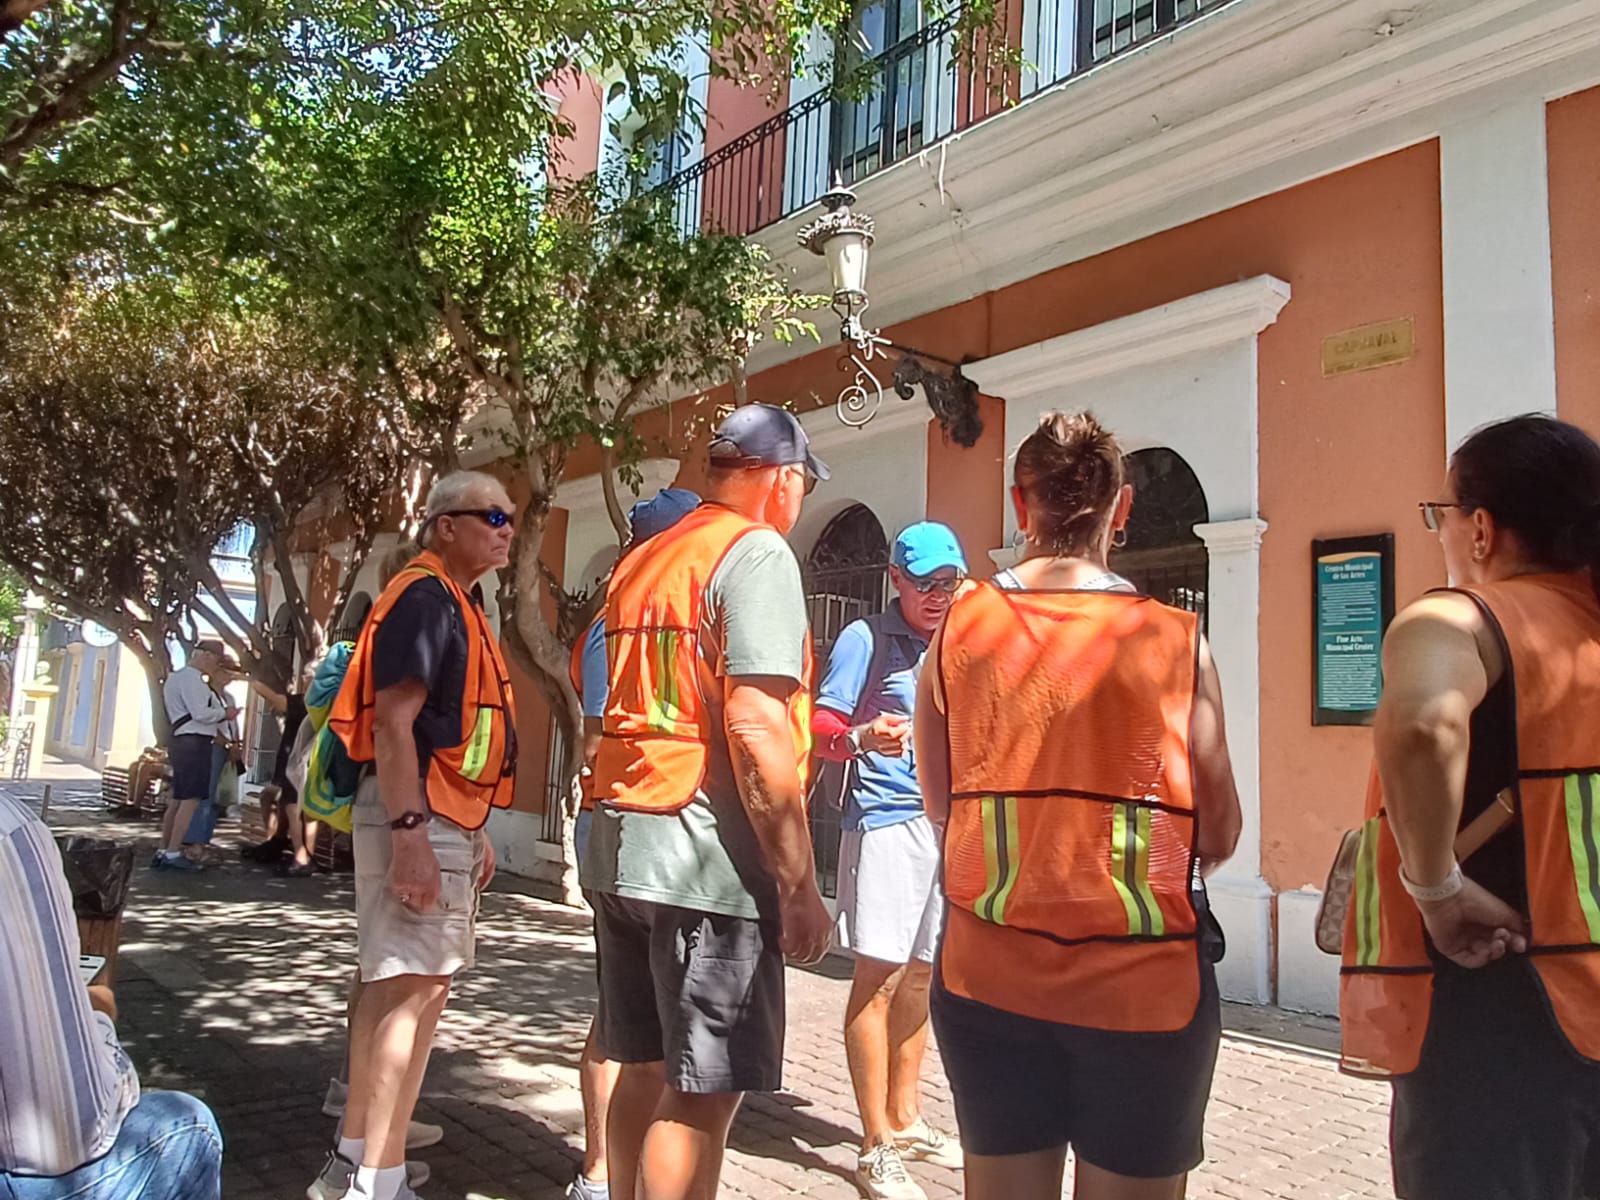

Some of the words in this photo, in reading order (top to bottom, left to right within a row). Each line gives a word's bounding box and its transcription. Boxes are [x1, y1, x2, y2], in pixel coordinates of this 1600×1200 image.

[1325, 565, 1343, 573] Centro
[1344, 562, 1374, 572] Municipal
[1350, 571, 1367, 579] Artes
[1336, 635, 1349, 643] Fine
[1326, 643, 1353, 652] Municipal
[1354, 643, 1374, 651] Center
